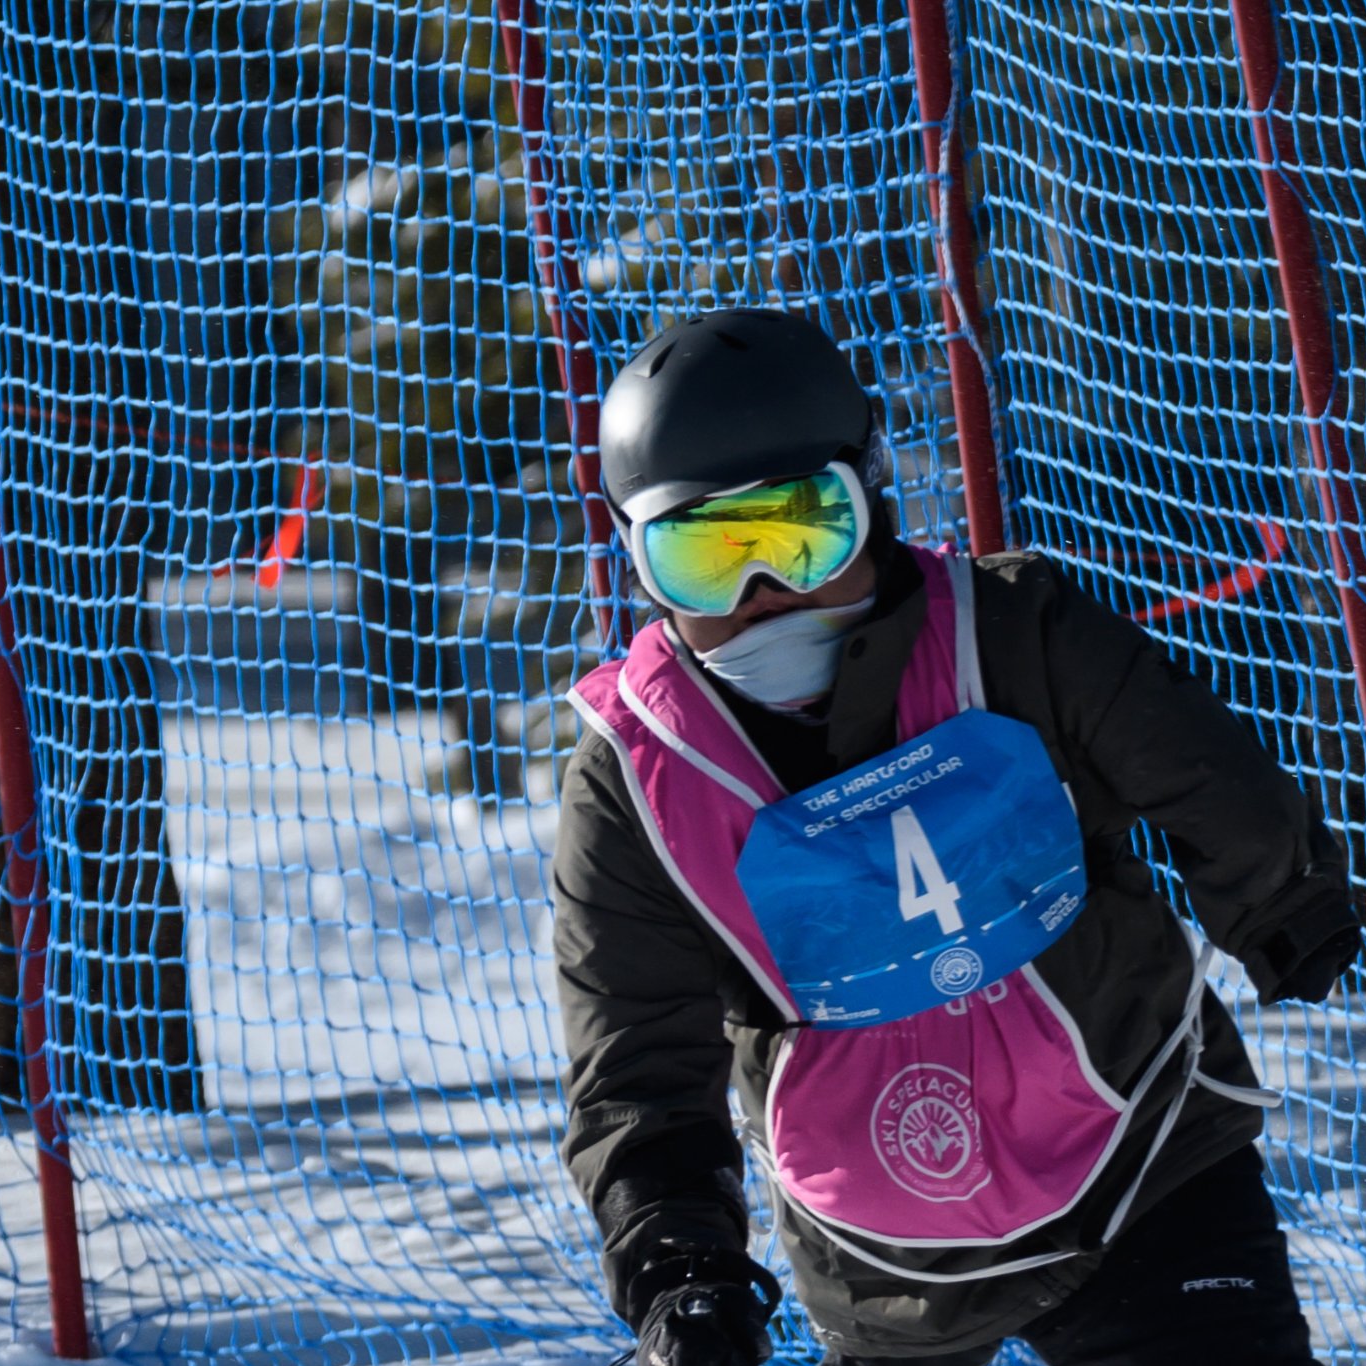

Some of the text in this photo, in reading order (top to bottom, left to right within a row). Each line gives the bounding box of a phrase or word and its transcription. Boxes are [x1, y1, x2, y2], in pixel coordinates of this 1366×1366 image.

[802, 743, 934, 812] THE HARTFORD
[803, 756, 964, 838] SKI SPECTACULAR
[891, 805, 964, 934] 4
[881, 1119, 900, 1157] SKI
